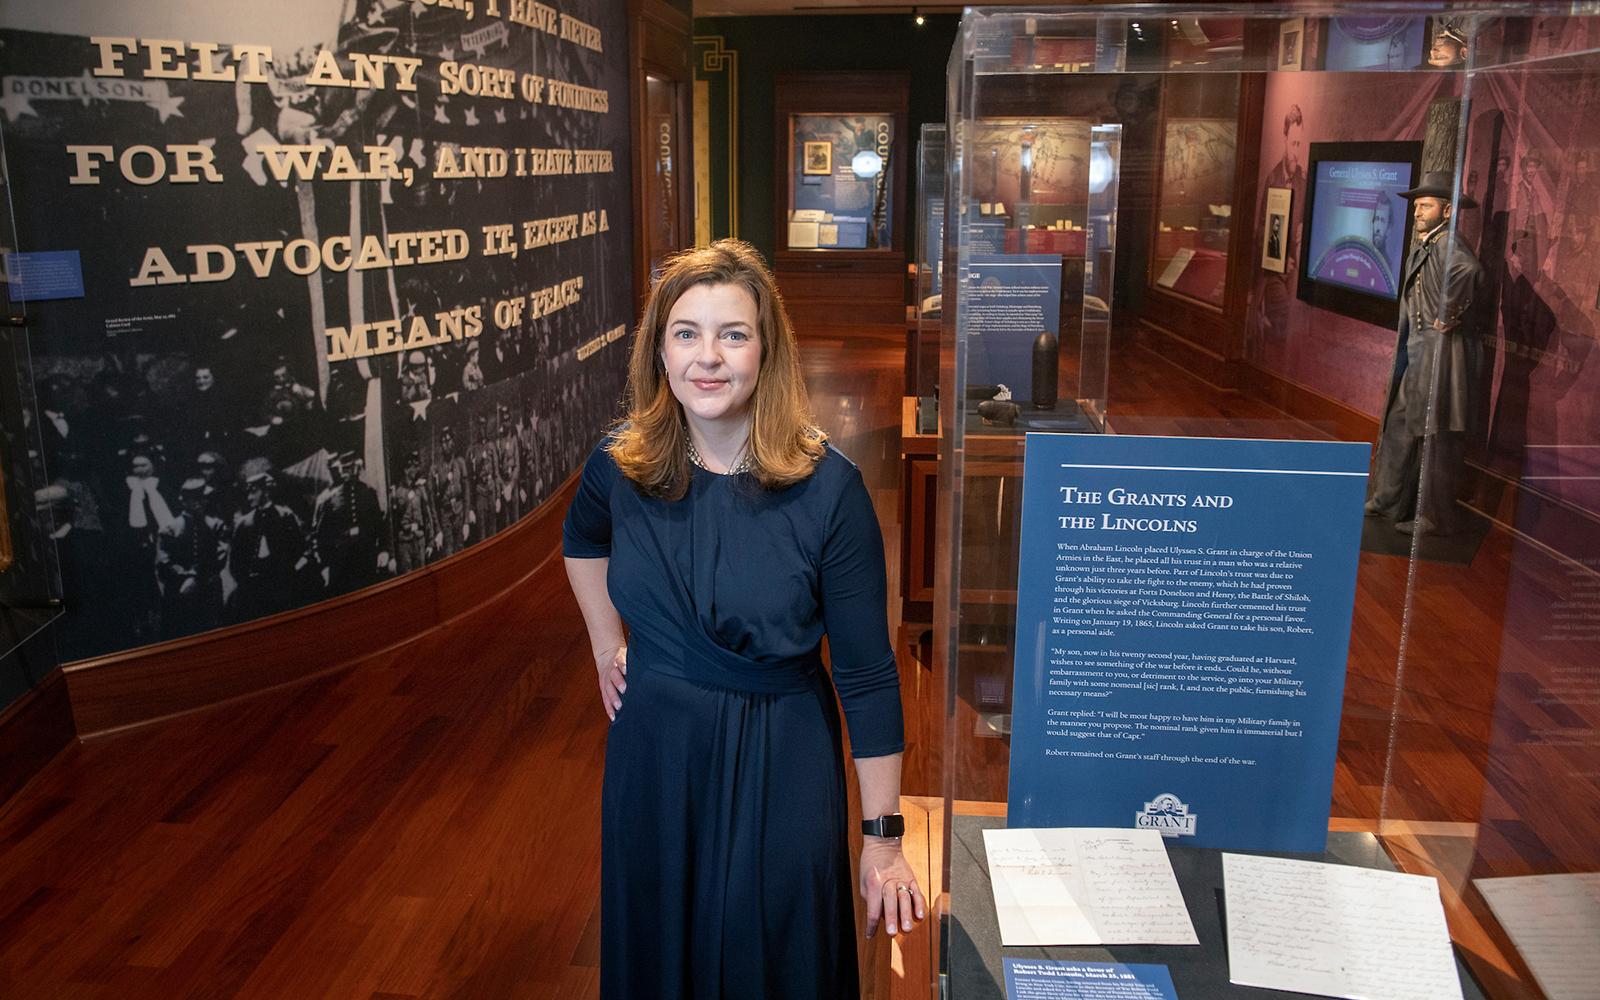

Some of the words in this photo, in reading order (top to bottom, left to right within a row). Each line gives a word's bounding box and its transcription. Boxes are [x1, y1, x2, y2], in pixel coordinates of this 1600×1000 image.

[509, 0, 558, 36] HAVE
[560, 13, 603, 53] NEVER
[90, 36, 273, 83] FELT
[305, 50, 423, 91] ANY
[439, 61, 516, 100] SORT
[521, 73, 545, 103] OF
[548, 79, 609, 113] FONDNESS
[66, 144, 224, 185] FOR
[256, 144, 414, 187] WAR,
[433, 146, 509, 179] AND
[515, 148, 528, 177] I
[531, 148, 574, 176] HAVE
[575, 149, 614, 174] NEVER
[129, 228, 470, 287] ADVOCATED
[482, 223, 518, 260] IT,
[523, 213, 579, 250] EXCEPT
[581, 210, 597, 237] AS
[599, 208, 610, 233] A
[325, 305, 484, 362] MEANS
[494, 296, 526, 330] OF
[1059, 486, 1102, 505] THE
[1107, 487, 1187, 507] GRANTS
[1192, 495, 1234, 509] AND
[1058, 516, 1096, 530] THE
[1100, 513, 1198, 533] LINCOLNS
[1079, 543, 1114, 552] Abraham
[1115, 544, 1143, 553] Lincoln
[1144, 545, 1168, 555] placed
[1170, 546, 1197, 556] Ulysses
[1206, 547, 1229, 556] Grant
[1238, 548, 1264, 558] charge
[1288, 551, 1313, 559] Union
[1056, 564, 1090, 572] unknown
[1146, 567, 1172, 575] before.
[1199, 569, 1234, 577] Lincoln's
[1054, 585, 1084, 595] through
[1159, 589, 1195, 597] Donelson
[1212, 591, 1237, 600] Henry,
[1283, 593, 1311, 602] Shiloh,
[1082, 596, 1112, 606] glorious
[1141, 599, 1180, 609] Vicksburg.
[1211, 601, 1238, 609] further
[1052, 616, 1081, 626] Writing
[1091, 618, 1121, 628] January
[1135, 620, 1154, 628] 1865,
[1156, 620, 1184, 628] Lincoln
[1286, 626, 1314, 634] Robert,
[1151, 610, 1202, 621] Commanding
[1233, 612, 1244, 620] for
[1251, 614, 1284, 623] personal
[1284, 614, 1306, 623] favor.
[1066, 628, 1098, 636] personal
[1048, 690, 1082, 698] necessary
[1159, 754, 1190, 764] through
[1138, 815, 1194, 828] GRANT
